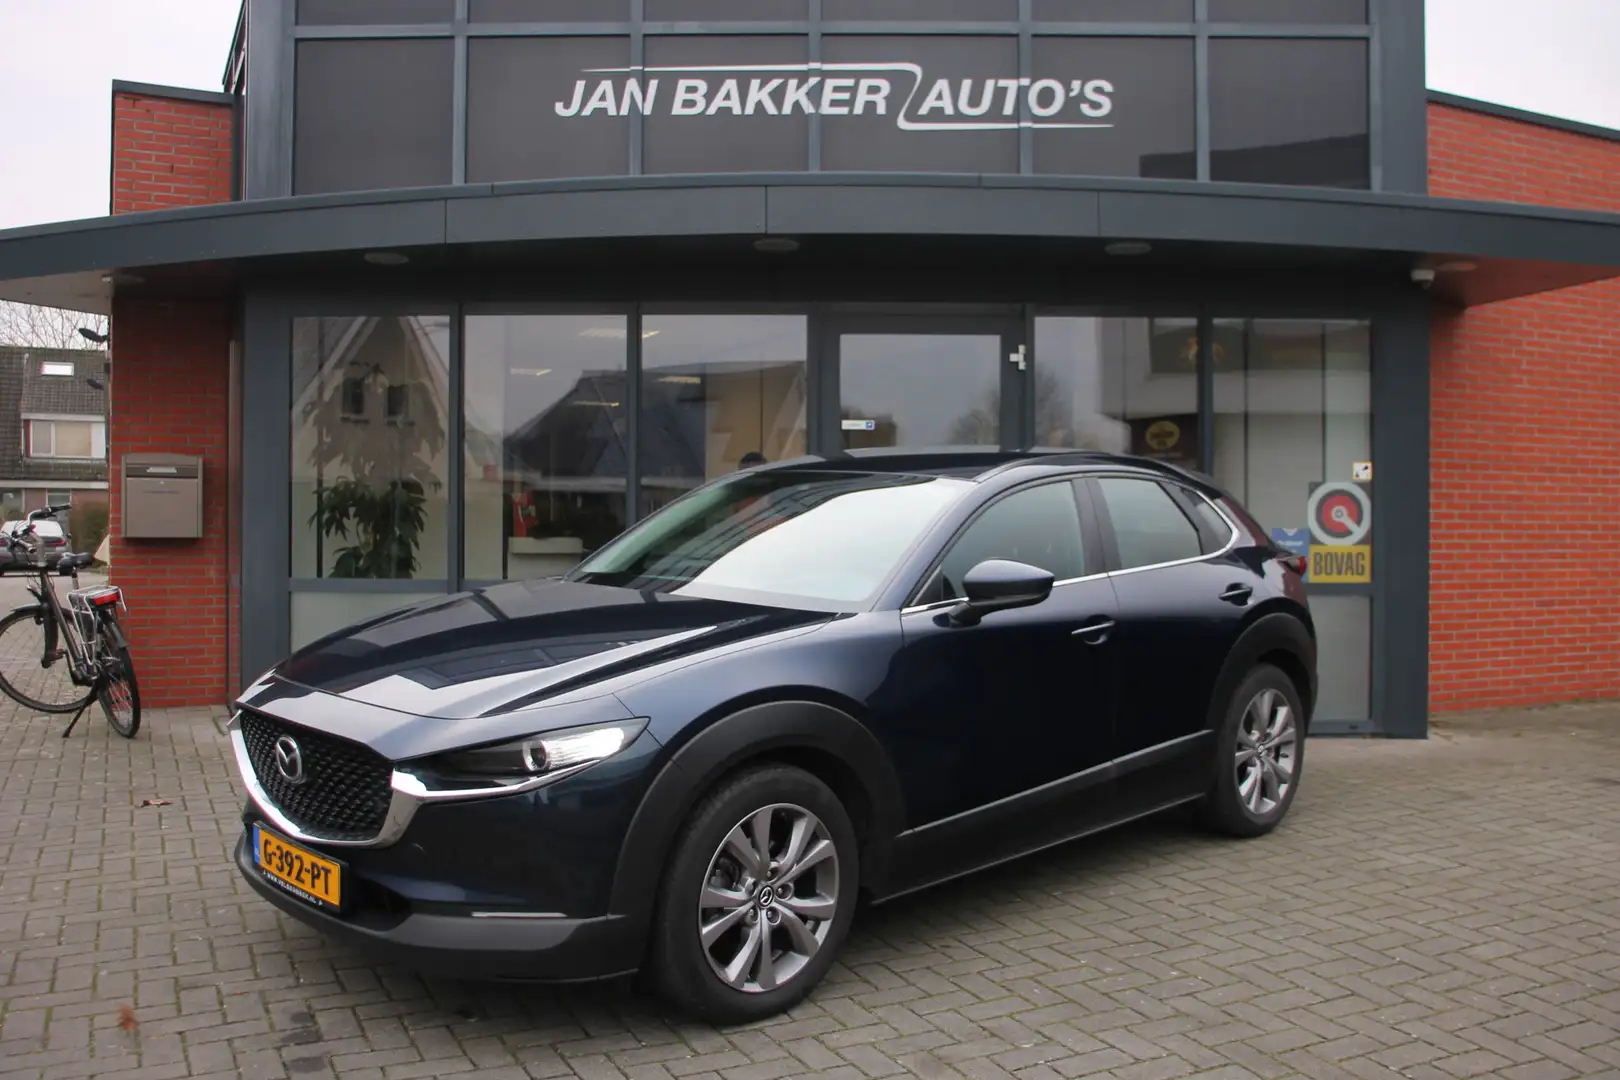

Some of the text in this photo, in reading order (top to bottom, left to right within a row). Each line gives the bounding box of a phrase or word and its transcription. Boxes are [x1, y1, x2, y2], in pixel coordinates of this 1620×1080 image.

[554, 77, 1115, 117] JAN BAKKER AUTO'S
[1313, 551, 1366, 577] BOVAG
[263, 838, 332, 896] G-392-PT
